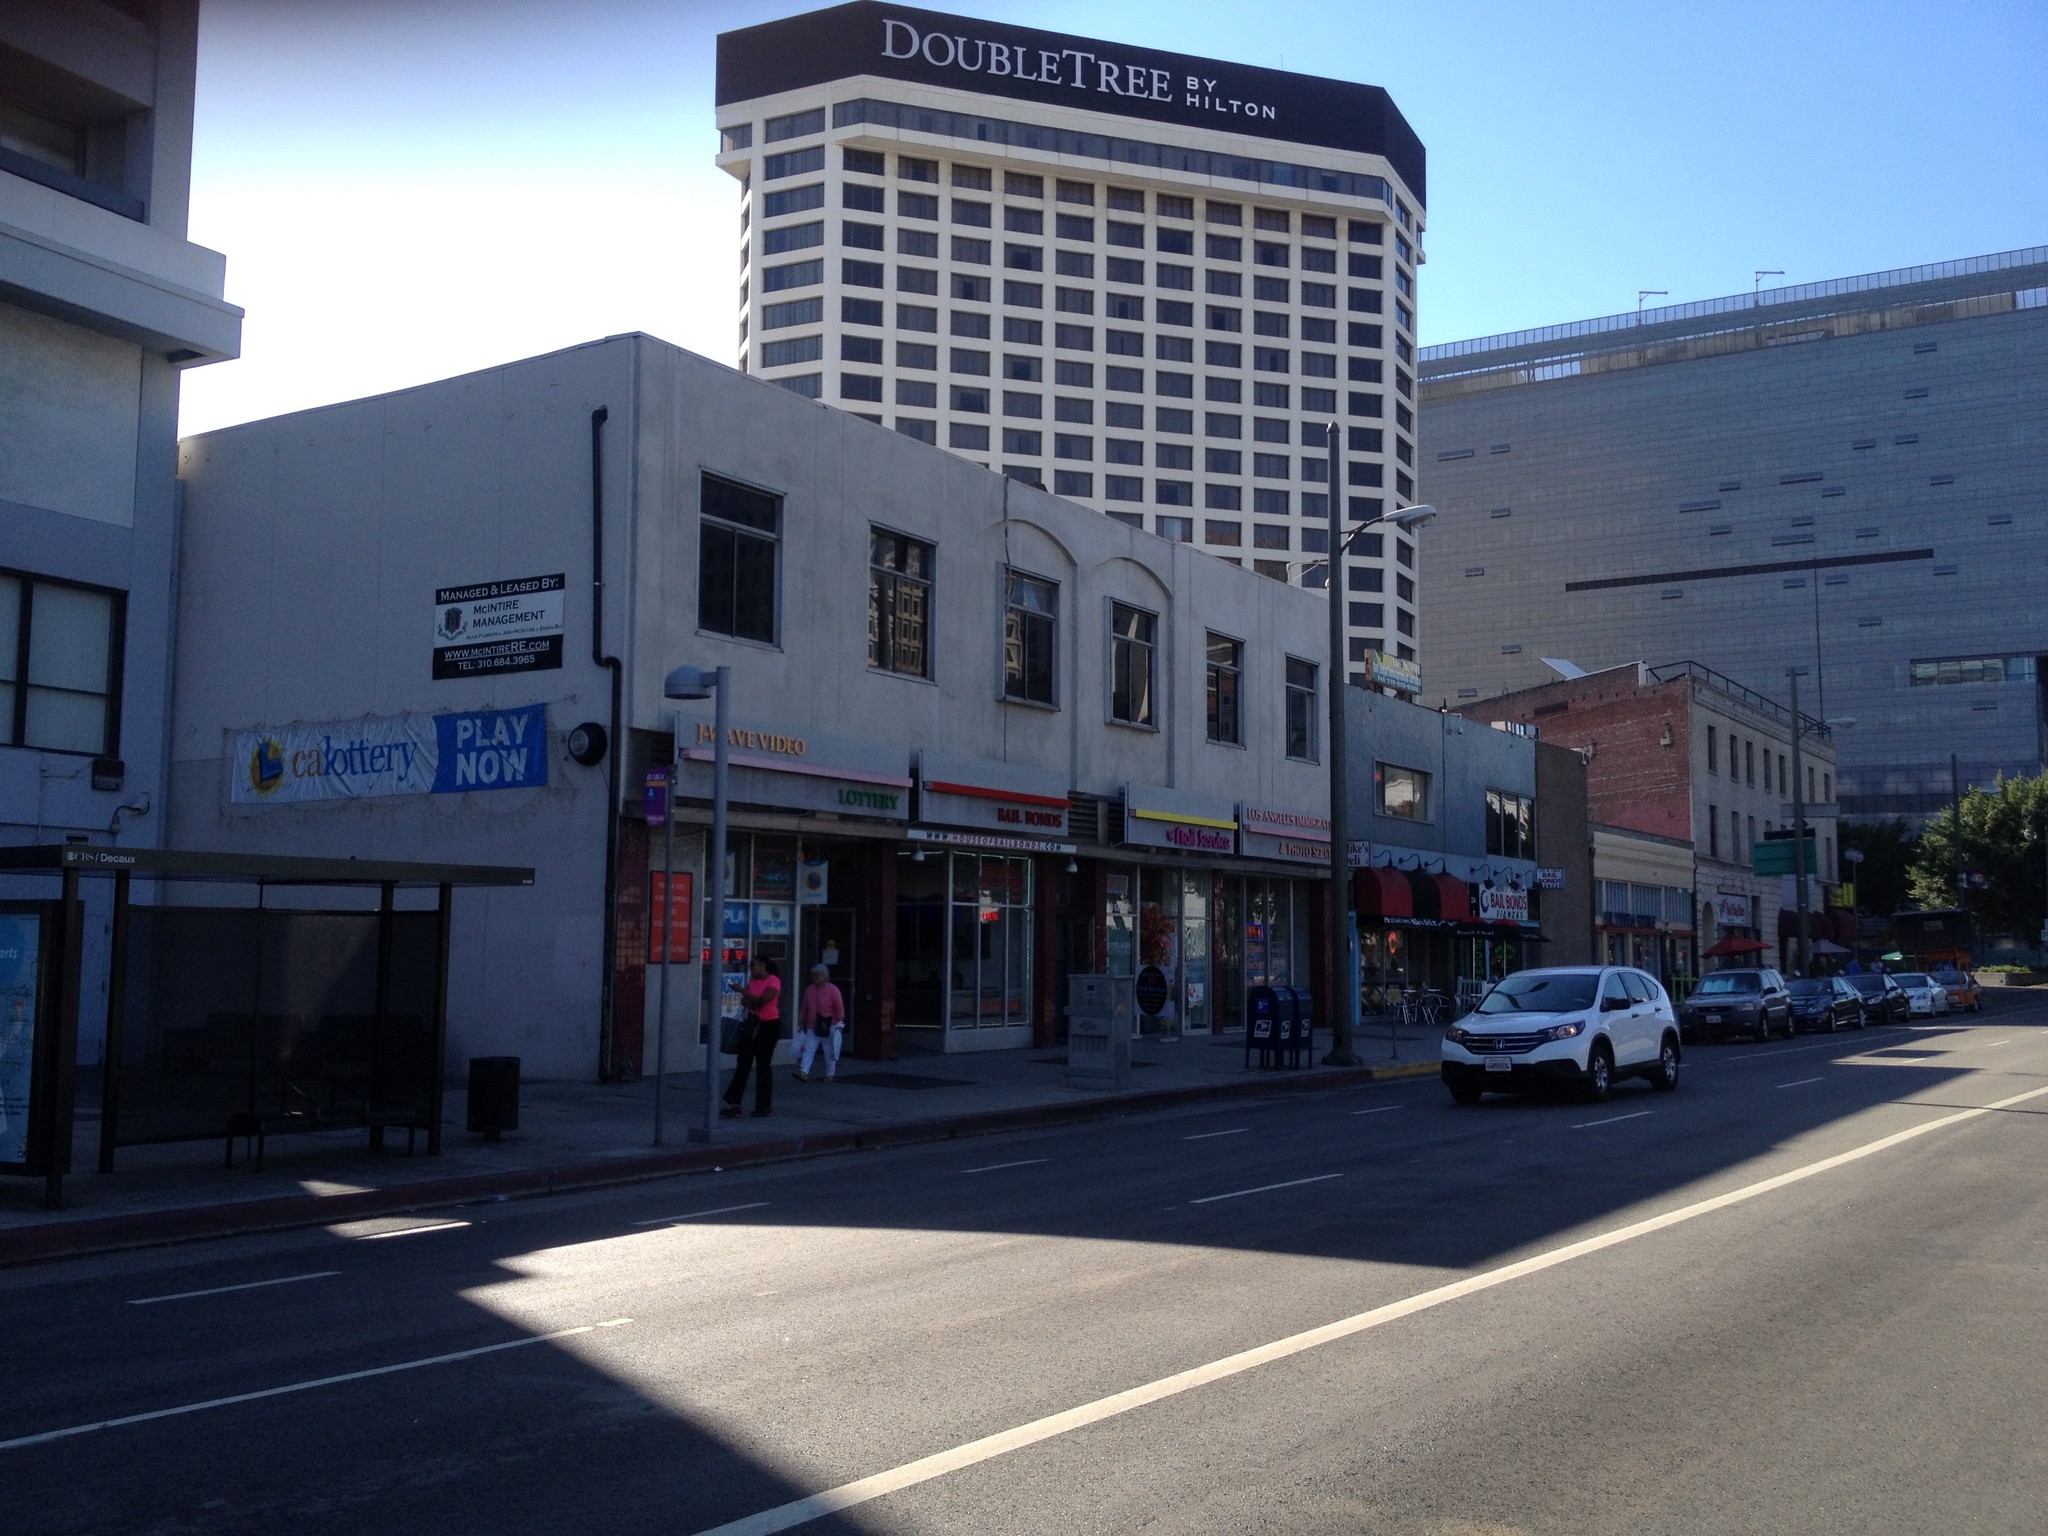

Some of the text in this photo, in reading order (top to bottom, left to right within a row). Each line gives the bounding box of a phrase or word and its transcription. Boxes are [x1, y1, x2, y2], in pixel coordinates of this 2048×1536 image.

[881, 18, 1173, 102] DOUBLETREE
[1186, 76, 1216, 92] BY
[1186, 93, 1275, 120] HILTON
[440, 587, 489, 602] MANAGED
[490, 584, 498, 595] &
[500, 580, 539, 594] LEASED
[472, 610, 545, 628] MANAGEMENT
[458, 655, 535, 670] TEL: 310.684.3965
[456, 715, 528, 749] PLAY
[758, 733, 806, 755] VIDEO
[456, 748, 527, 785] NOW
[838, 789, 898, 809] LOTTERY
[997, 807, 1062, 827] BAIL BONDS
[1247, 808, 1261, 820] LOS
[1263, 811, 1293, 825] ANGELES
[100, 852, 136, 864] Decaux
[1287, 844, 1310, 857] PHOTO
[1347, 855, 1360, 866] eli
[1490, 893, 1527, 910] BAIL BONDS
